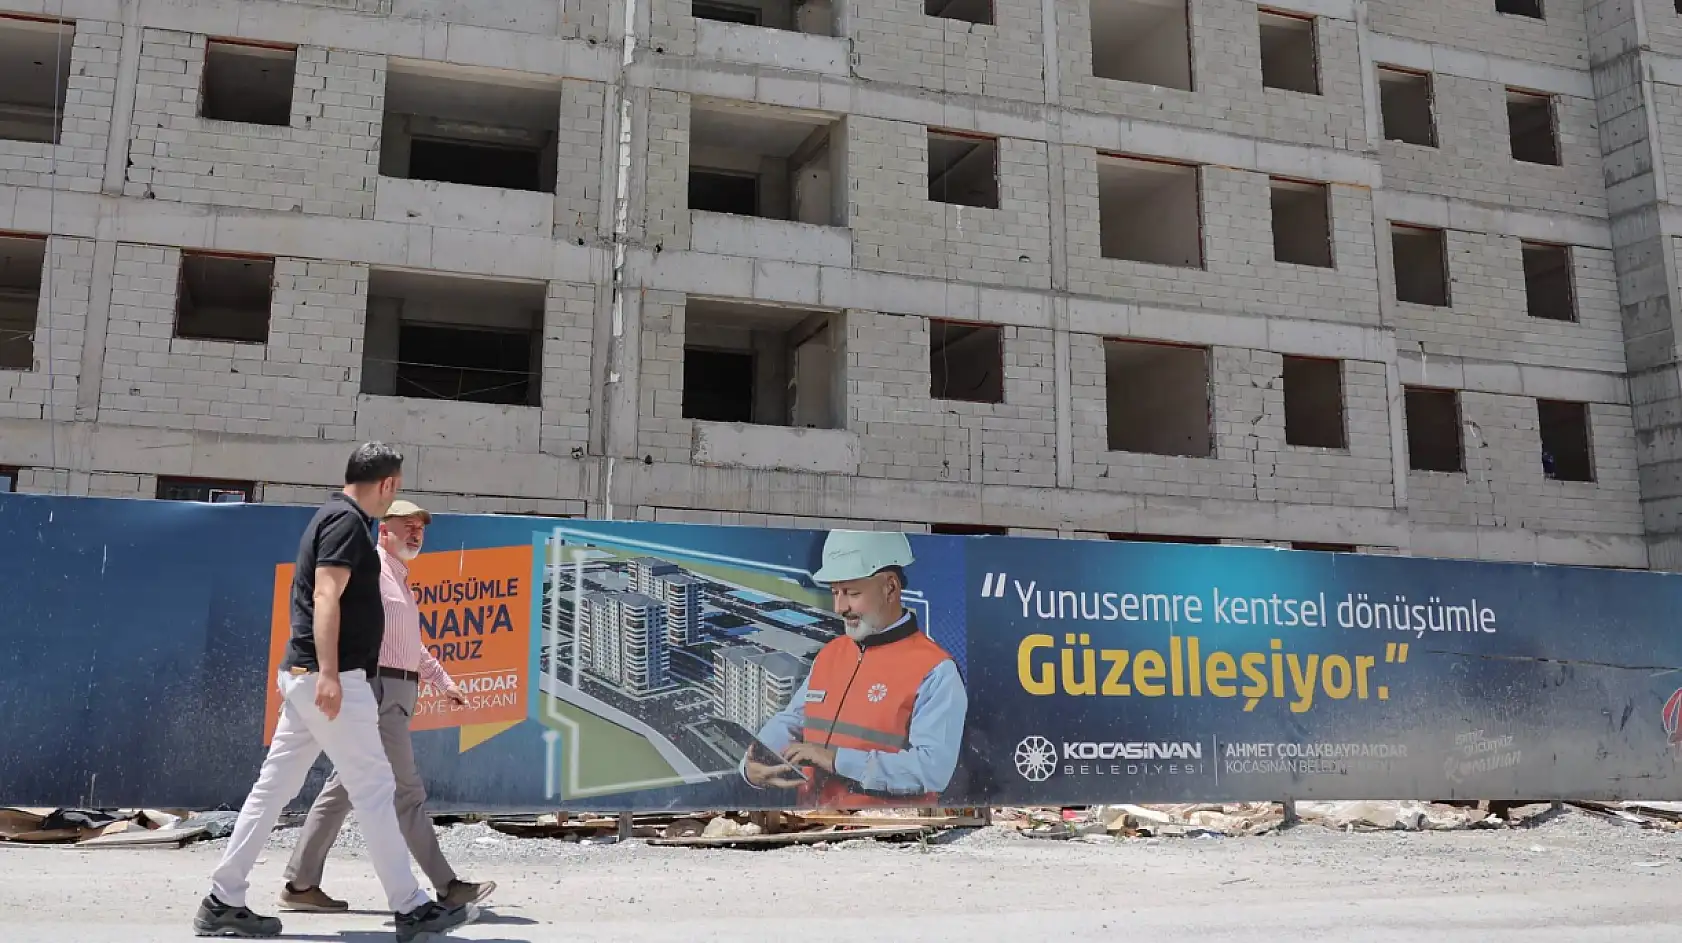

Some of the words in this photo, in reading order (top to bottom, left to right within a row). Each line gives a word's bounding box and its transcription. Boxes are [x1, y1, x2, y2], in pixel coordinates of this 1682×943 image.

[411, 577, 519, 605] ÖNÜŞÜMLE
[419, 604, 513, 640] NAN’A
[1213, 587, 1327, 628] kentsel
[1337, 593, 1497, 639] dönüşümle
[424, 640, 483, 662] ORUZ
[1226, 743, 1275, 757] AHMET
